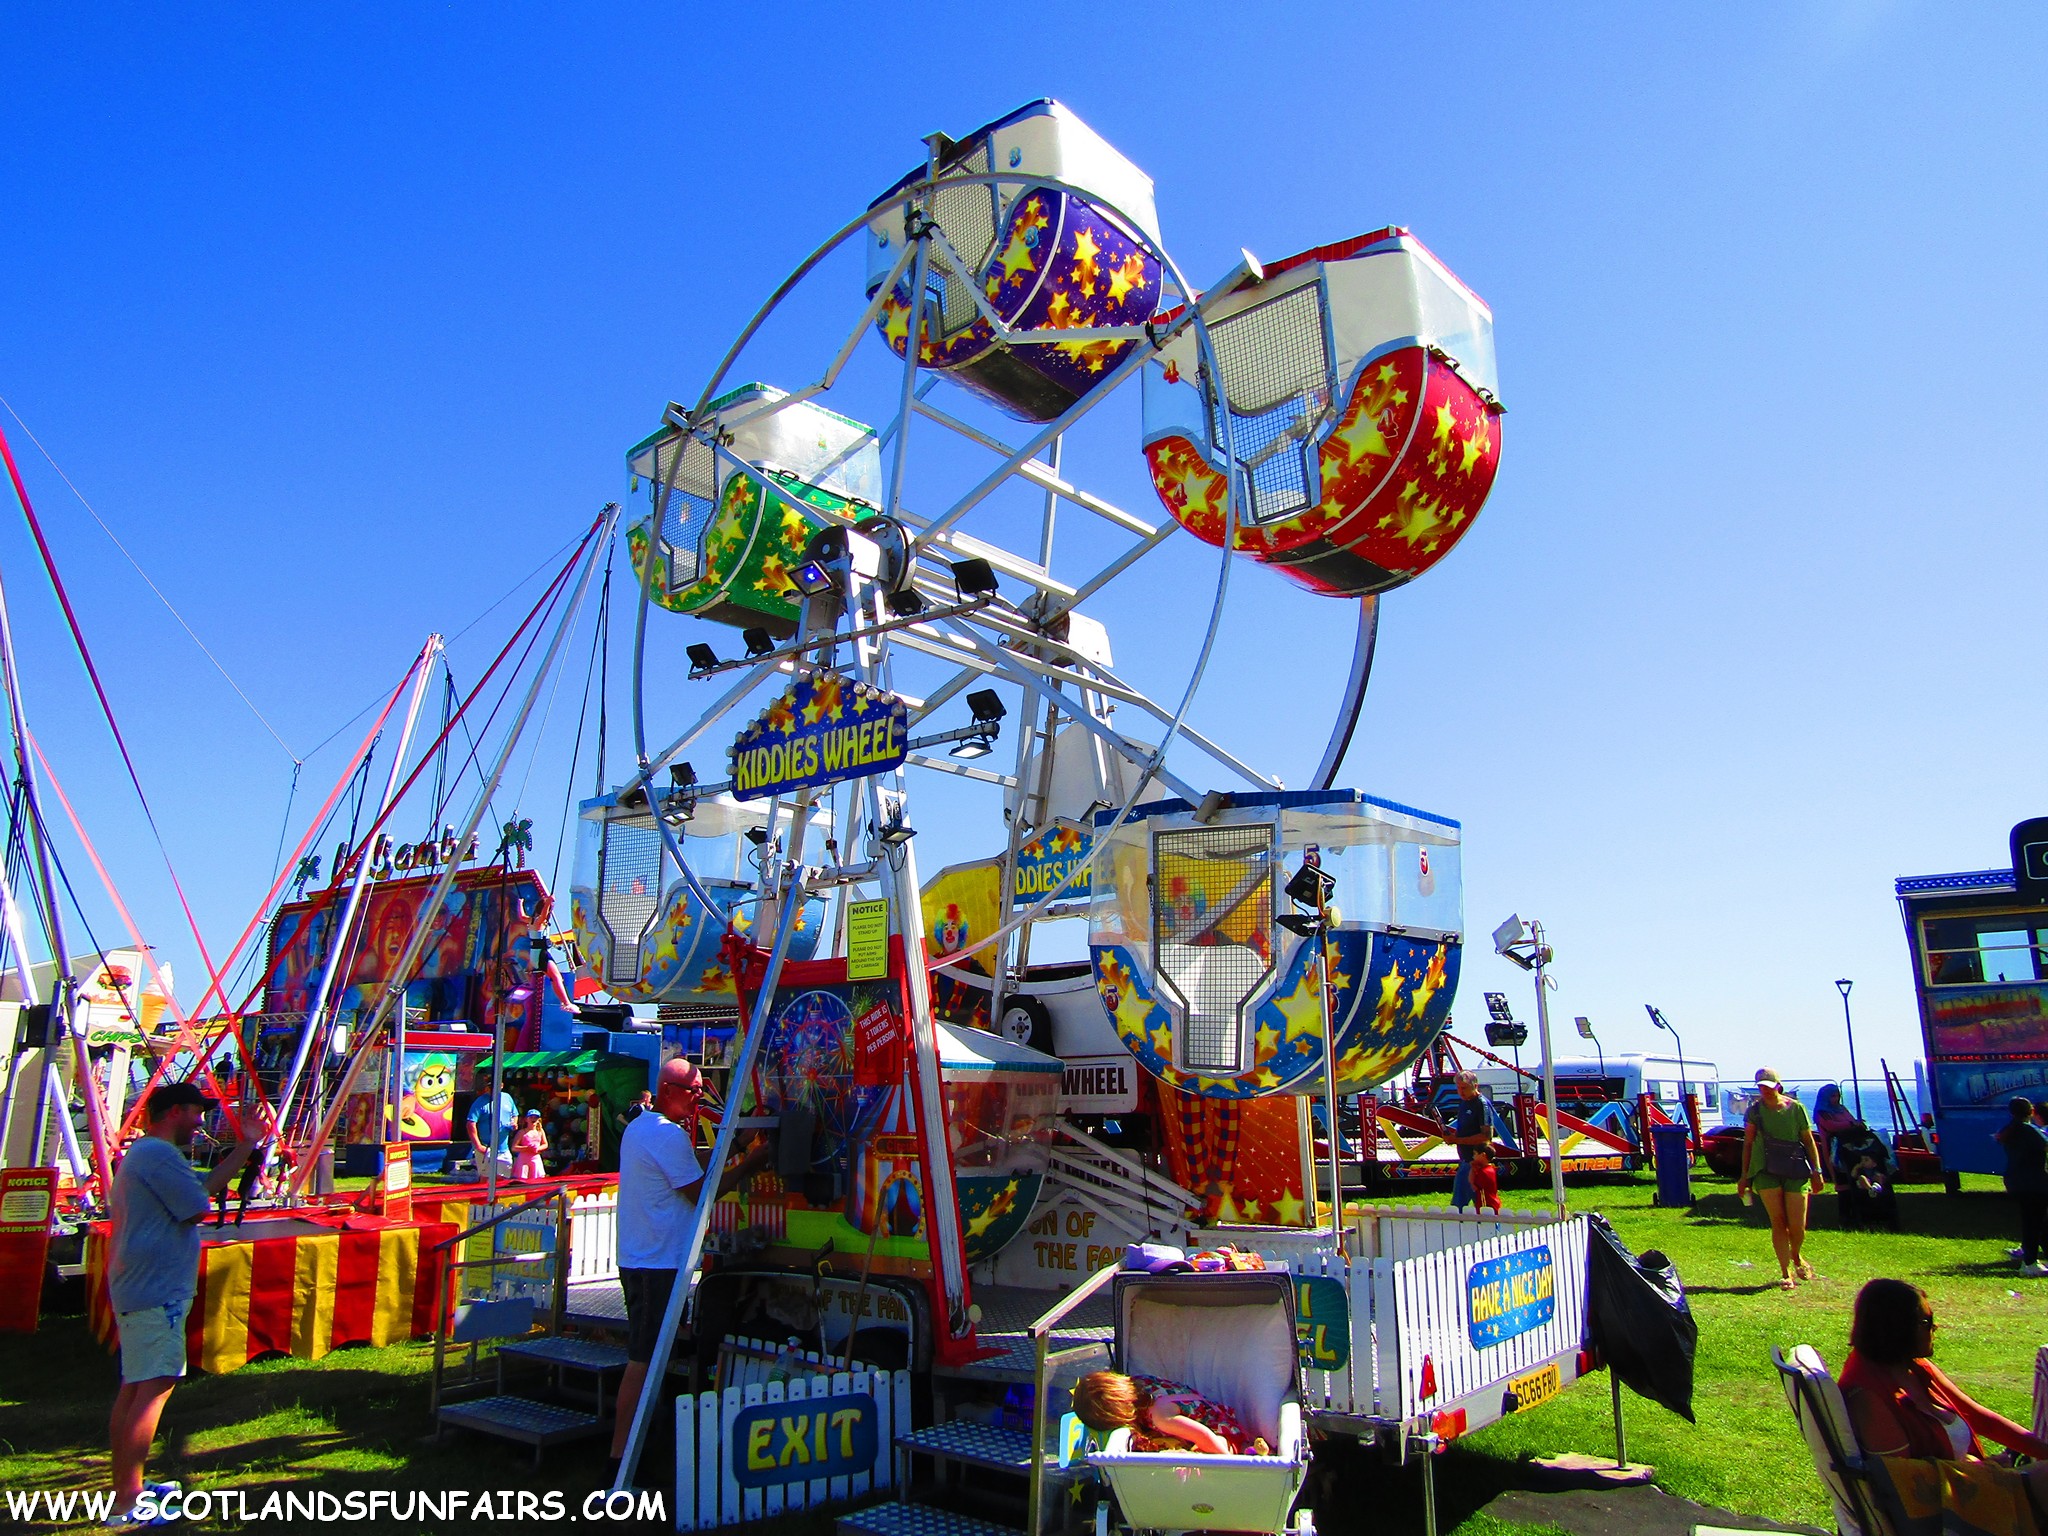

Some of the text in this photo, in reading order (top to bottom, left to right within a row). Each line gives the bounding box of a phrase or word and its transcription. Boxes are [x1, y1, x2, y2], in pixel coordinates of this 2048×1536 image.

[1376, 408, 1399, 439] 4
[1173, 481, 1188, 508] 4
[737, 716, 900, 791] KIDDIES WHEEL
[852, 904, 883, 915] NOTICE
[859, 1004, 888, 1029] THIS RIDE IS
[90, 1030, 143, 1043] CHIPS
[866, 1028, 896, 1054] PER PERSON
[1061, 1067, 1129, 1096] WHEEL
[1365, 1107, 1376, 1156] EVANS
[1525, 1107, 1537, 1153] EVANS
[1561, 1156, 1623, 1172] EXTREME
[7, 1177, 49, 1187] NOTICE
[1066, 1210, 1096, 1238] OF
[504, 1227, 542, 1252] MINI
[1033, 1241, 1078, 1271] THE
[1472, 1264, 1553, 1324] HAVE A NICE DAY
[1515, 1376, 1542, 1408] SC66
[747, 1408, 863, 1471] EXIT
